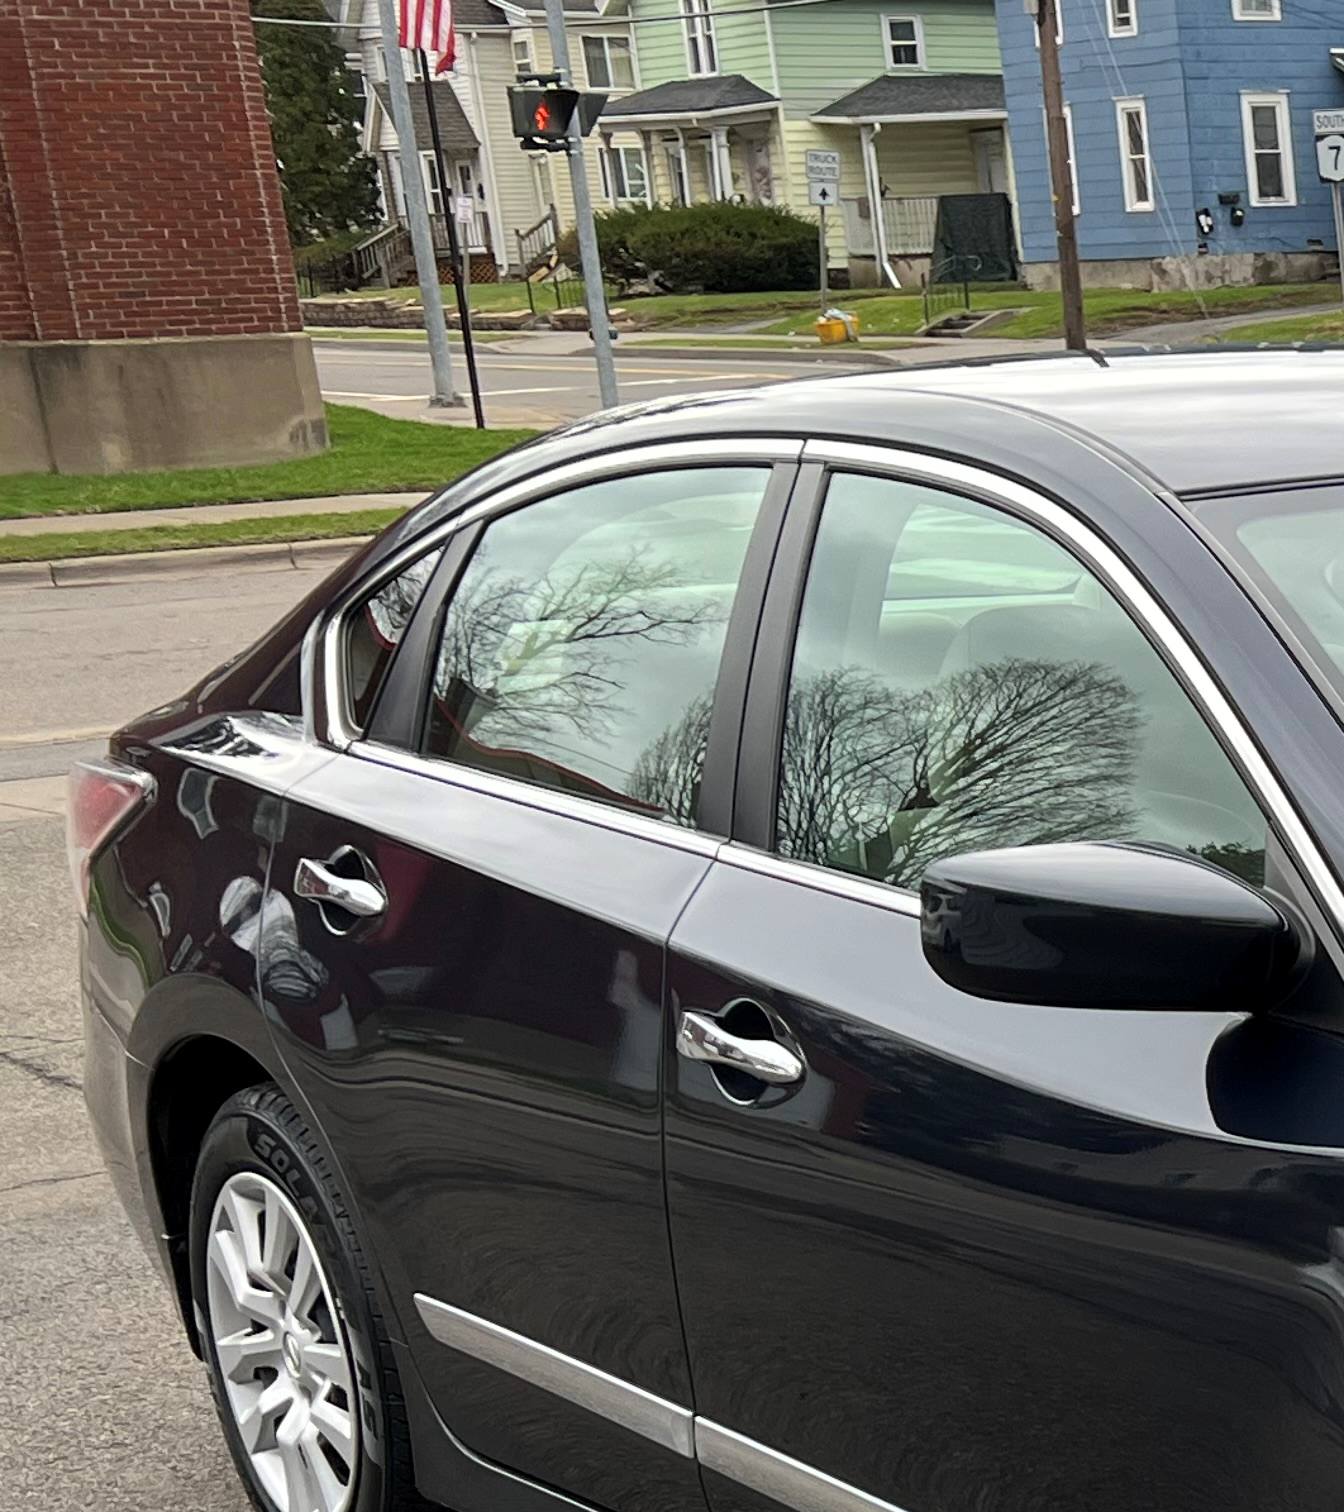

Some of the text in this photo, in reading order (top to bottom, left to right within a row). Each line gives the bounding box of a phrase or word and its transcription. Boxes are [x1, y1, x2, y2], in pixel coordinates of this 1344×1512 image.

[807, 152, 837, 164] TRUCK
[1328, 145, 1341, 171] 7
[807, 165, 838, 177] ROUTE
